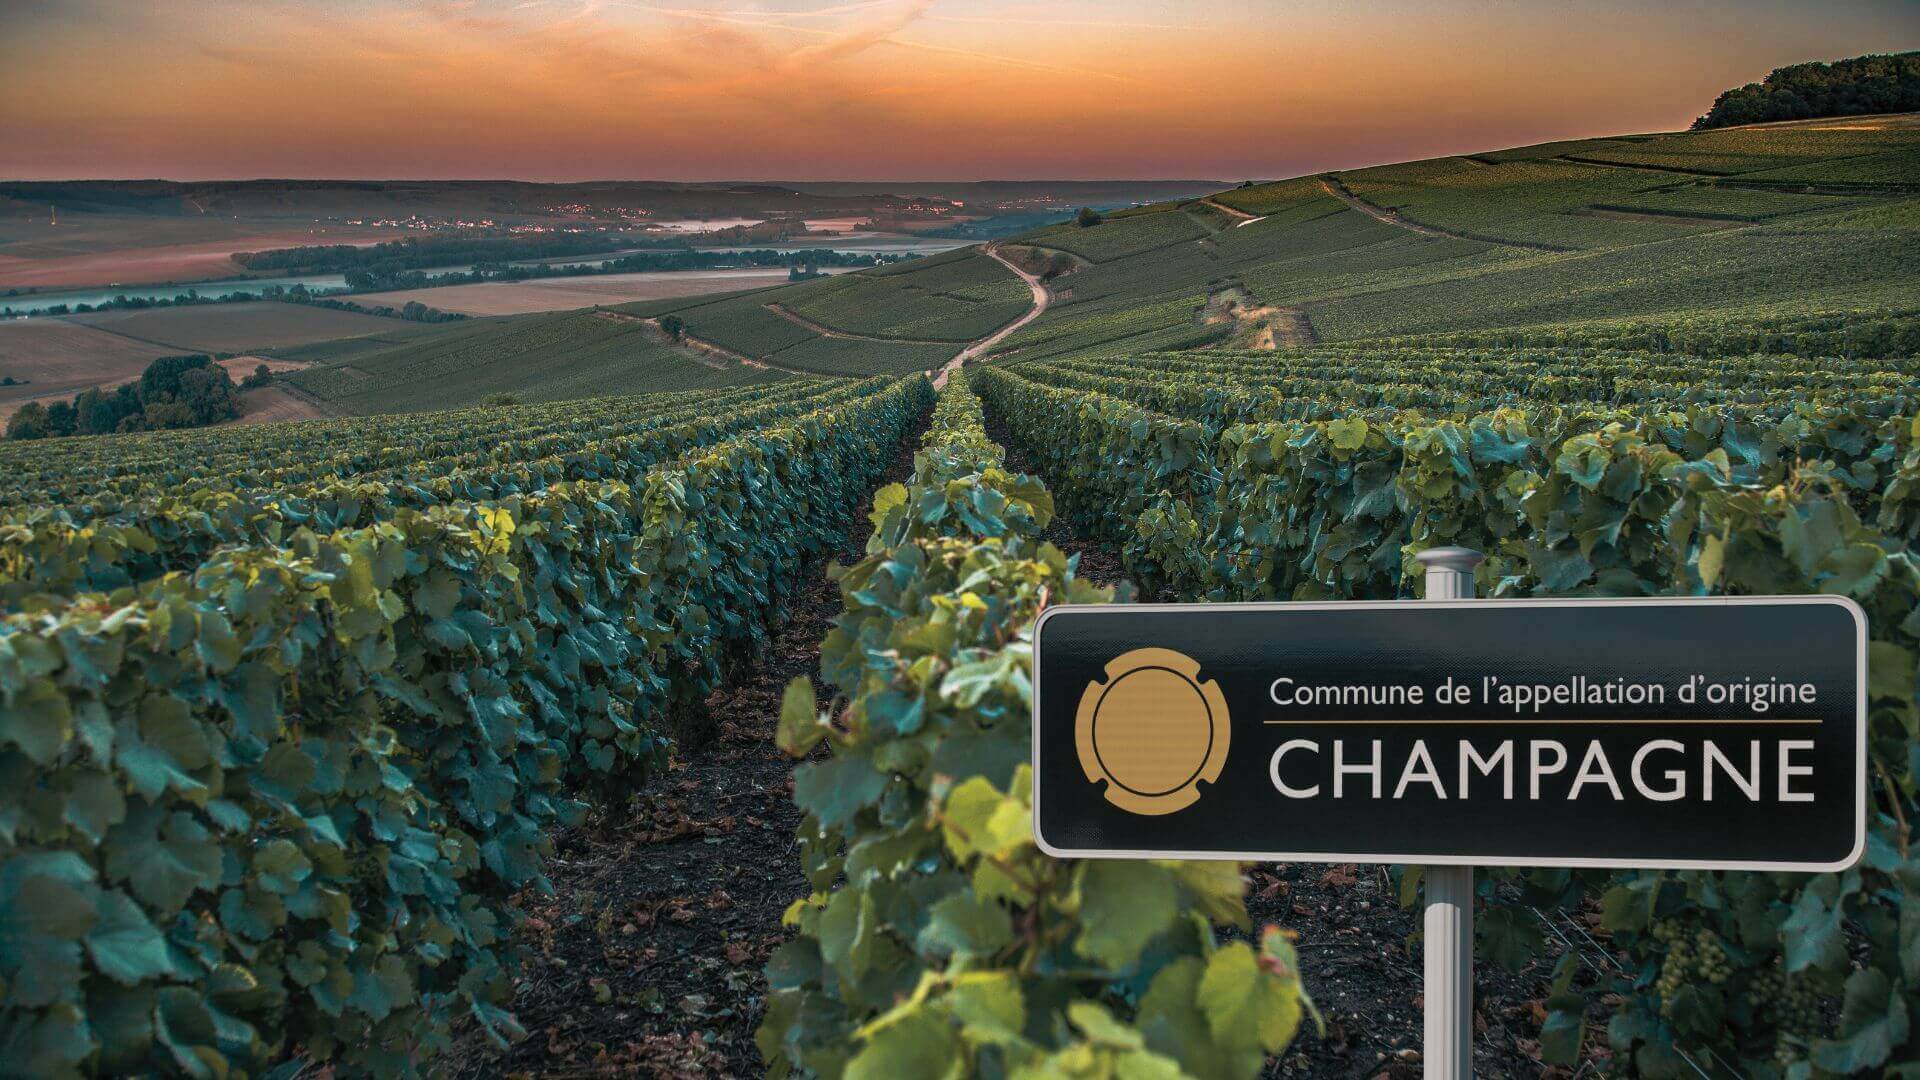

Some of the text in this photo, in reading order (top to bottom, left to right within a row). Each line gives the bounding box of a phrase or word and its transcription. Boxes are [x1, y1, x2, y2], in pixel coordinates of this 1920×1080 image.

[1270, 677, 1425, 705] Commune
[1435, 676, 1471, 704] de
[1269, 739, 1815, 802] CHAMPAGNE
